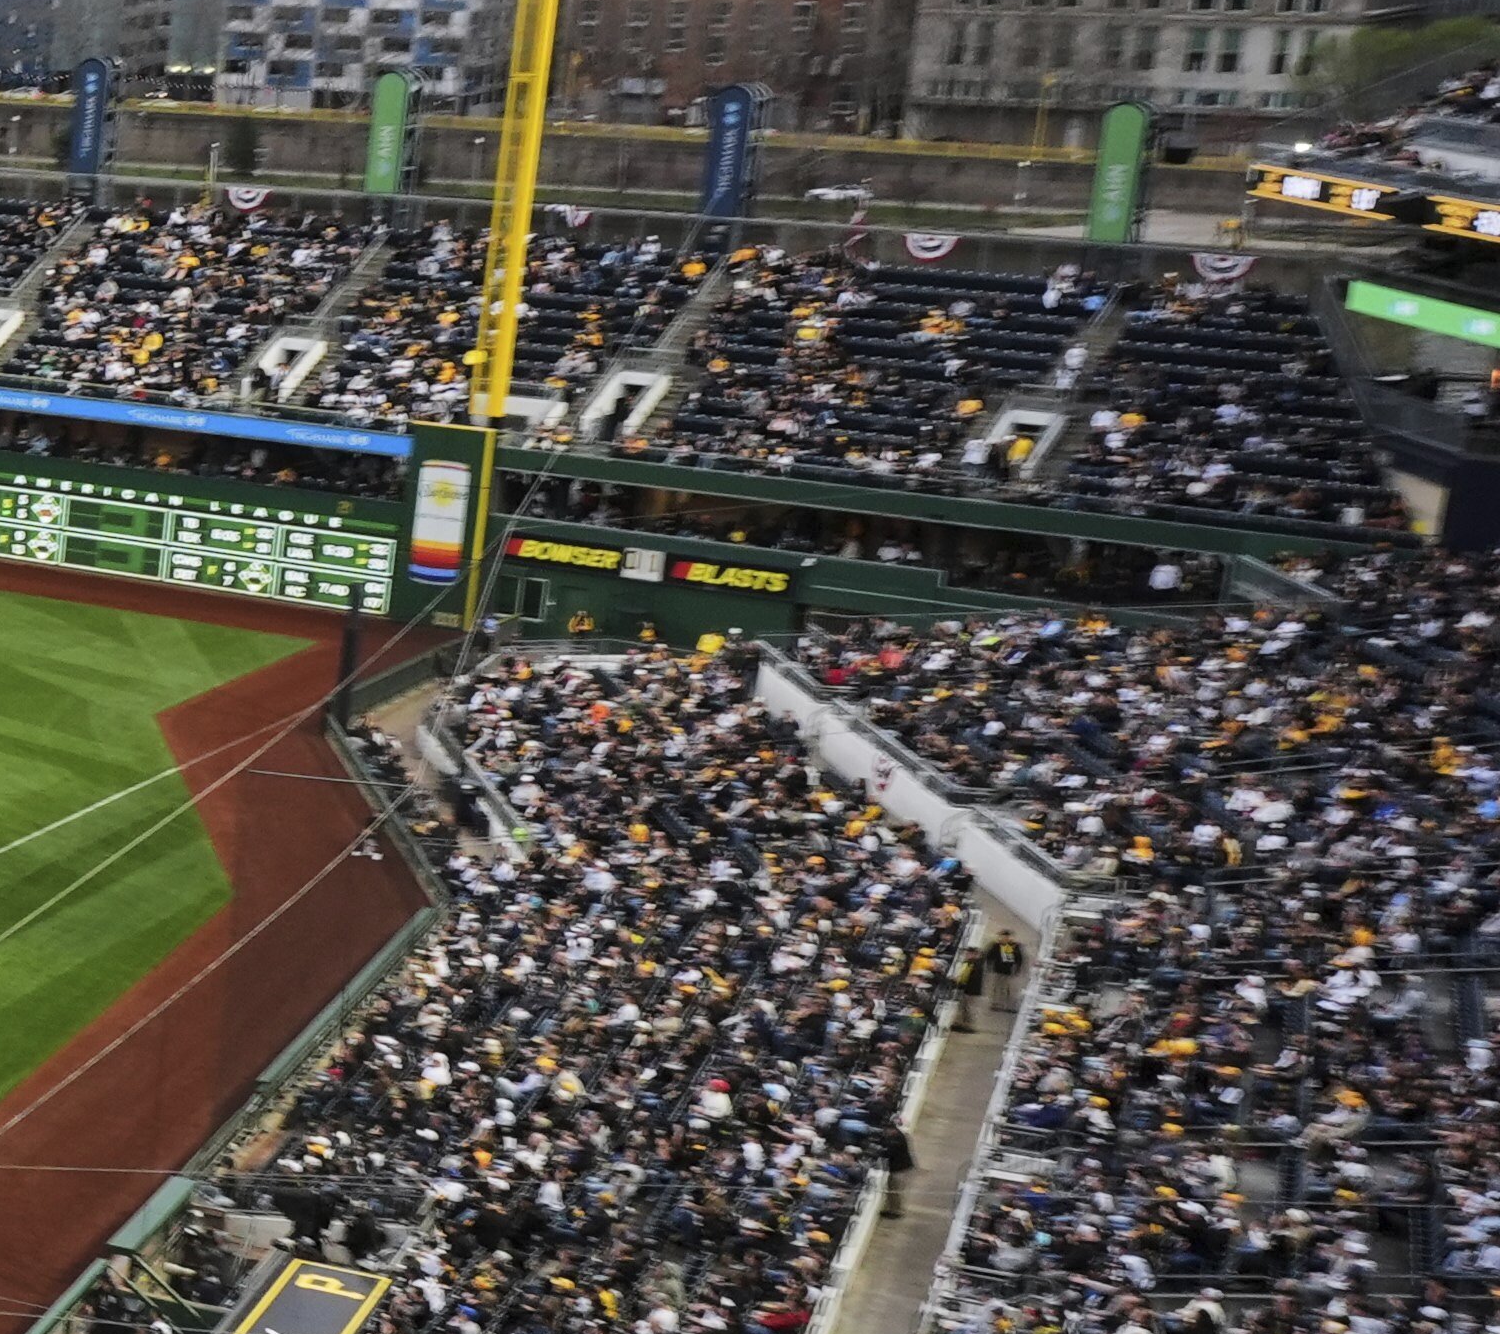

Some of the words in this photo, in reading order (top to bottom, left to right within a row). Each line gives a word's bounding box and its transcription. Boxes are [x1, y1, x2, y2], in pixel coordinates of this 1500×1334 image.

[13, 474, 183, 506] AMERICAN
[209, 500, 343, 529] LEAGUE
[517, 539, 622, 571] BOWSER
[686, 560, 790, 593] BLASTS
